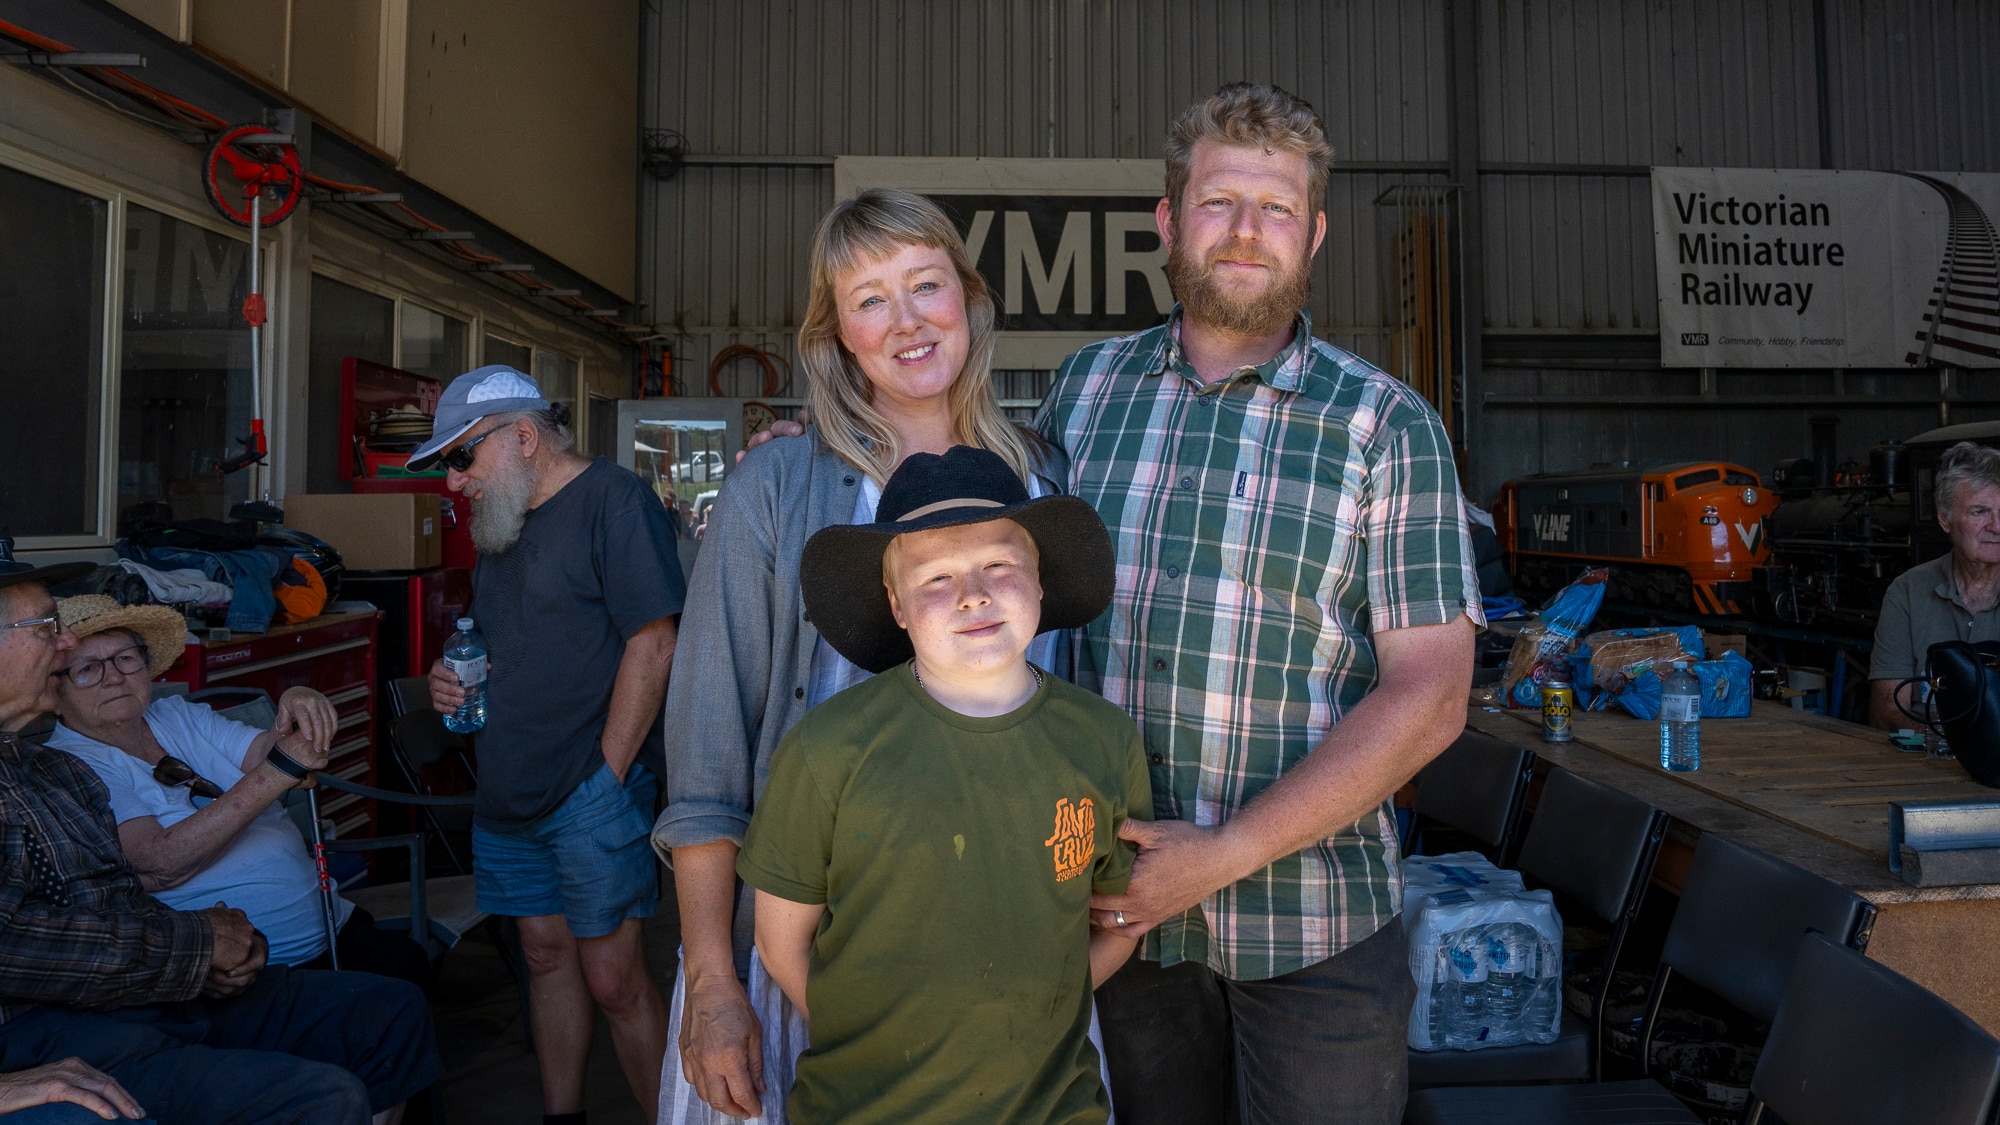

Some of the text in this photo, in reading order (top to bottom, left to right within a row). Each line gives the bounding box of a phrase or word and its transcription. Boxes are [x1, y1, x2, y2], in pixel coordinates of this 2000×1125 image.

[1673, 192, 1830, 226] Victorian
[1678, 232, 1845, 267] Miniature
[1681, 272, 1813, 316] Railway
[1683, 334, 1708, 345] VMR
[1544, 706, 1570, 716] SOLO
[1054, 830, 1095, 873] CRUZ
